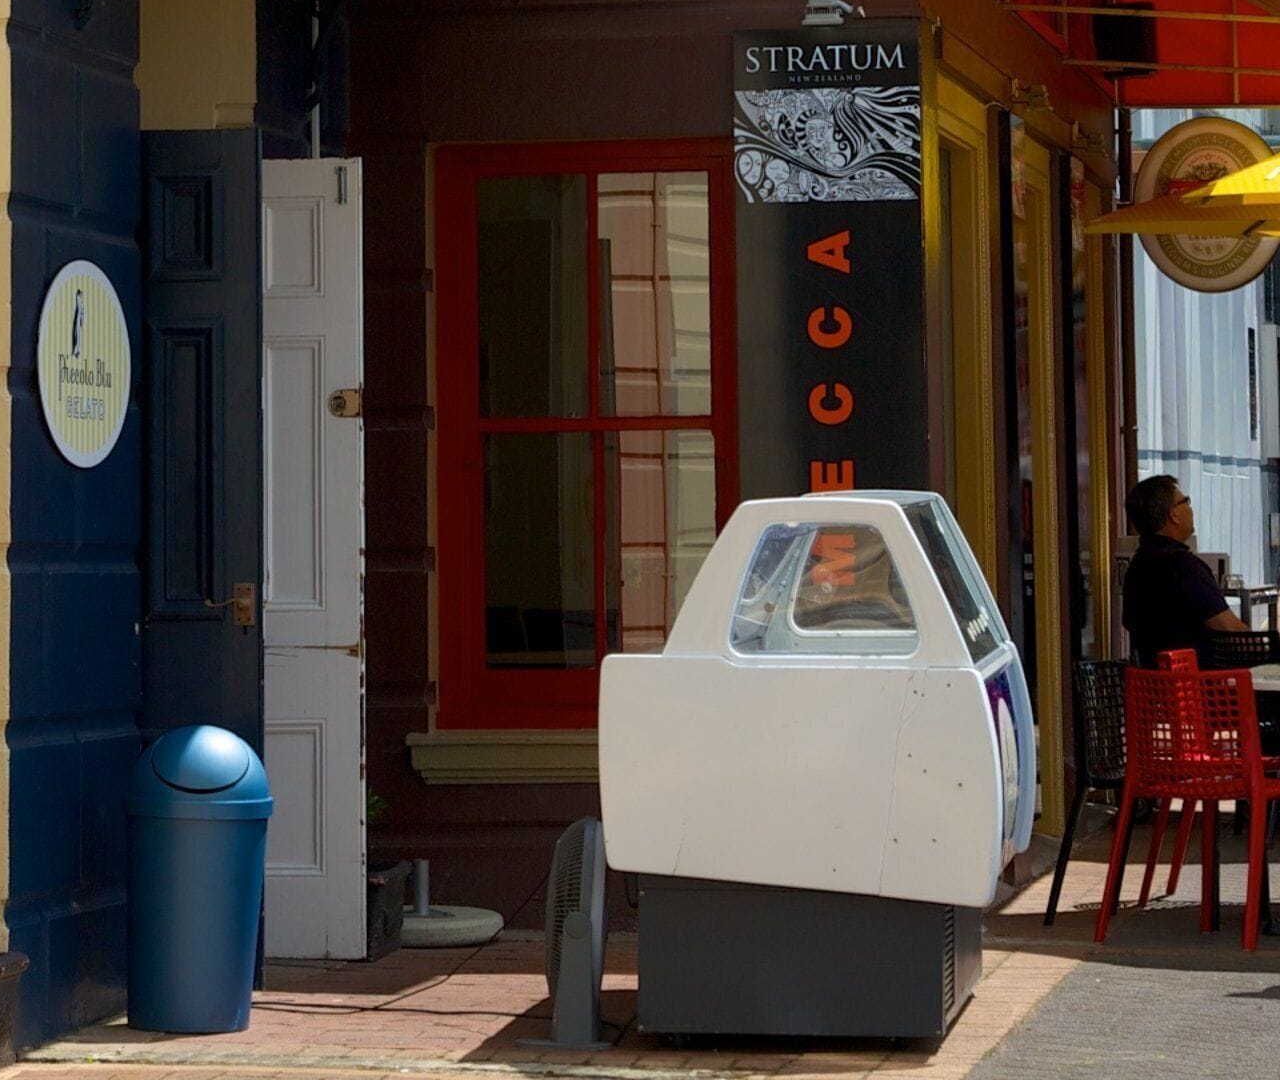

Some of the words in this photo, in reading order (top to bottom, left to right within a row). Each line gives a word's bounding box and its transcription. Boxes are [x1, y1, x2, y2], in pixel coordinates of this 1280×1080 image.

[746, 44, 906, 73] STRATUM
[814, 74, 861, 82] ZEALAND
[58, 353, 94, 402] Piccolo
[96, 358, 112, 388] Blu
[65, 396, 105, 421] GELATO
